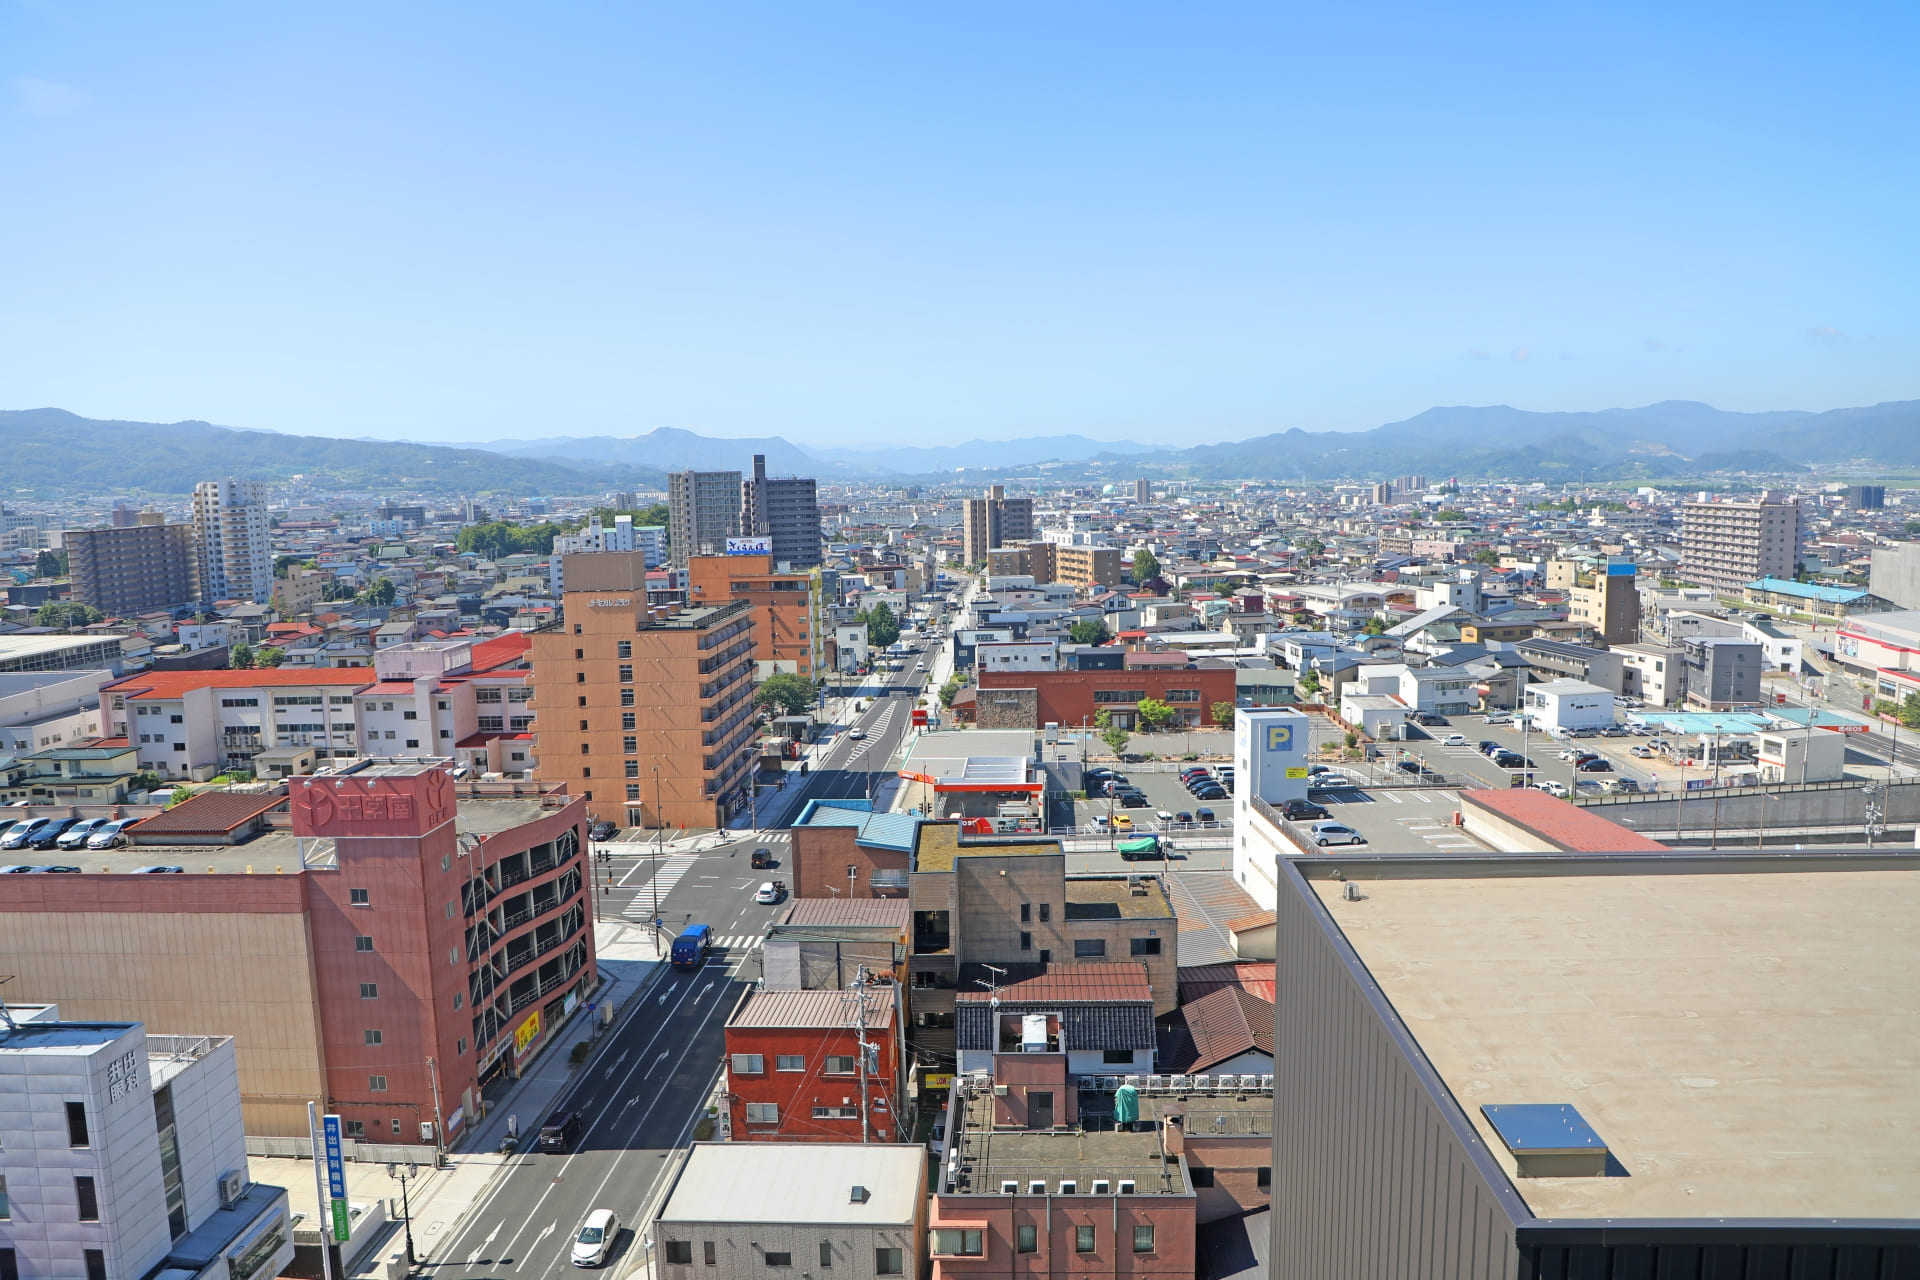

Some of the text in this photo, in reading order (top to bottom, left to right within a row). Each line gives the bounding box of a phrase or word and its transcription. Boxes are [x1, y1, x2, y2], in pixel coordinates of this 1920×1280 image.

[1270, 728, 1290, 749] P
[108, 1050, 136, 1082] 井出
[110, 1070, 139, 1104] 眼科
[326, 1123, 342, 1193] 井出眼科病院
